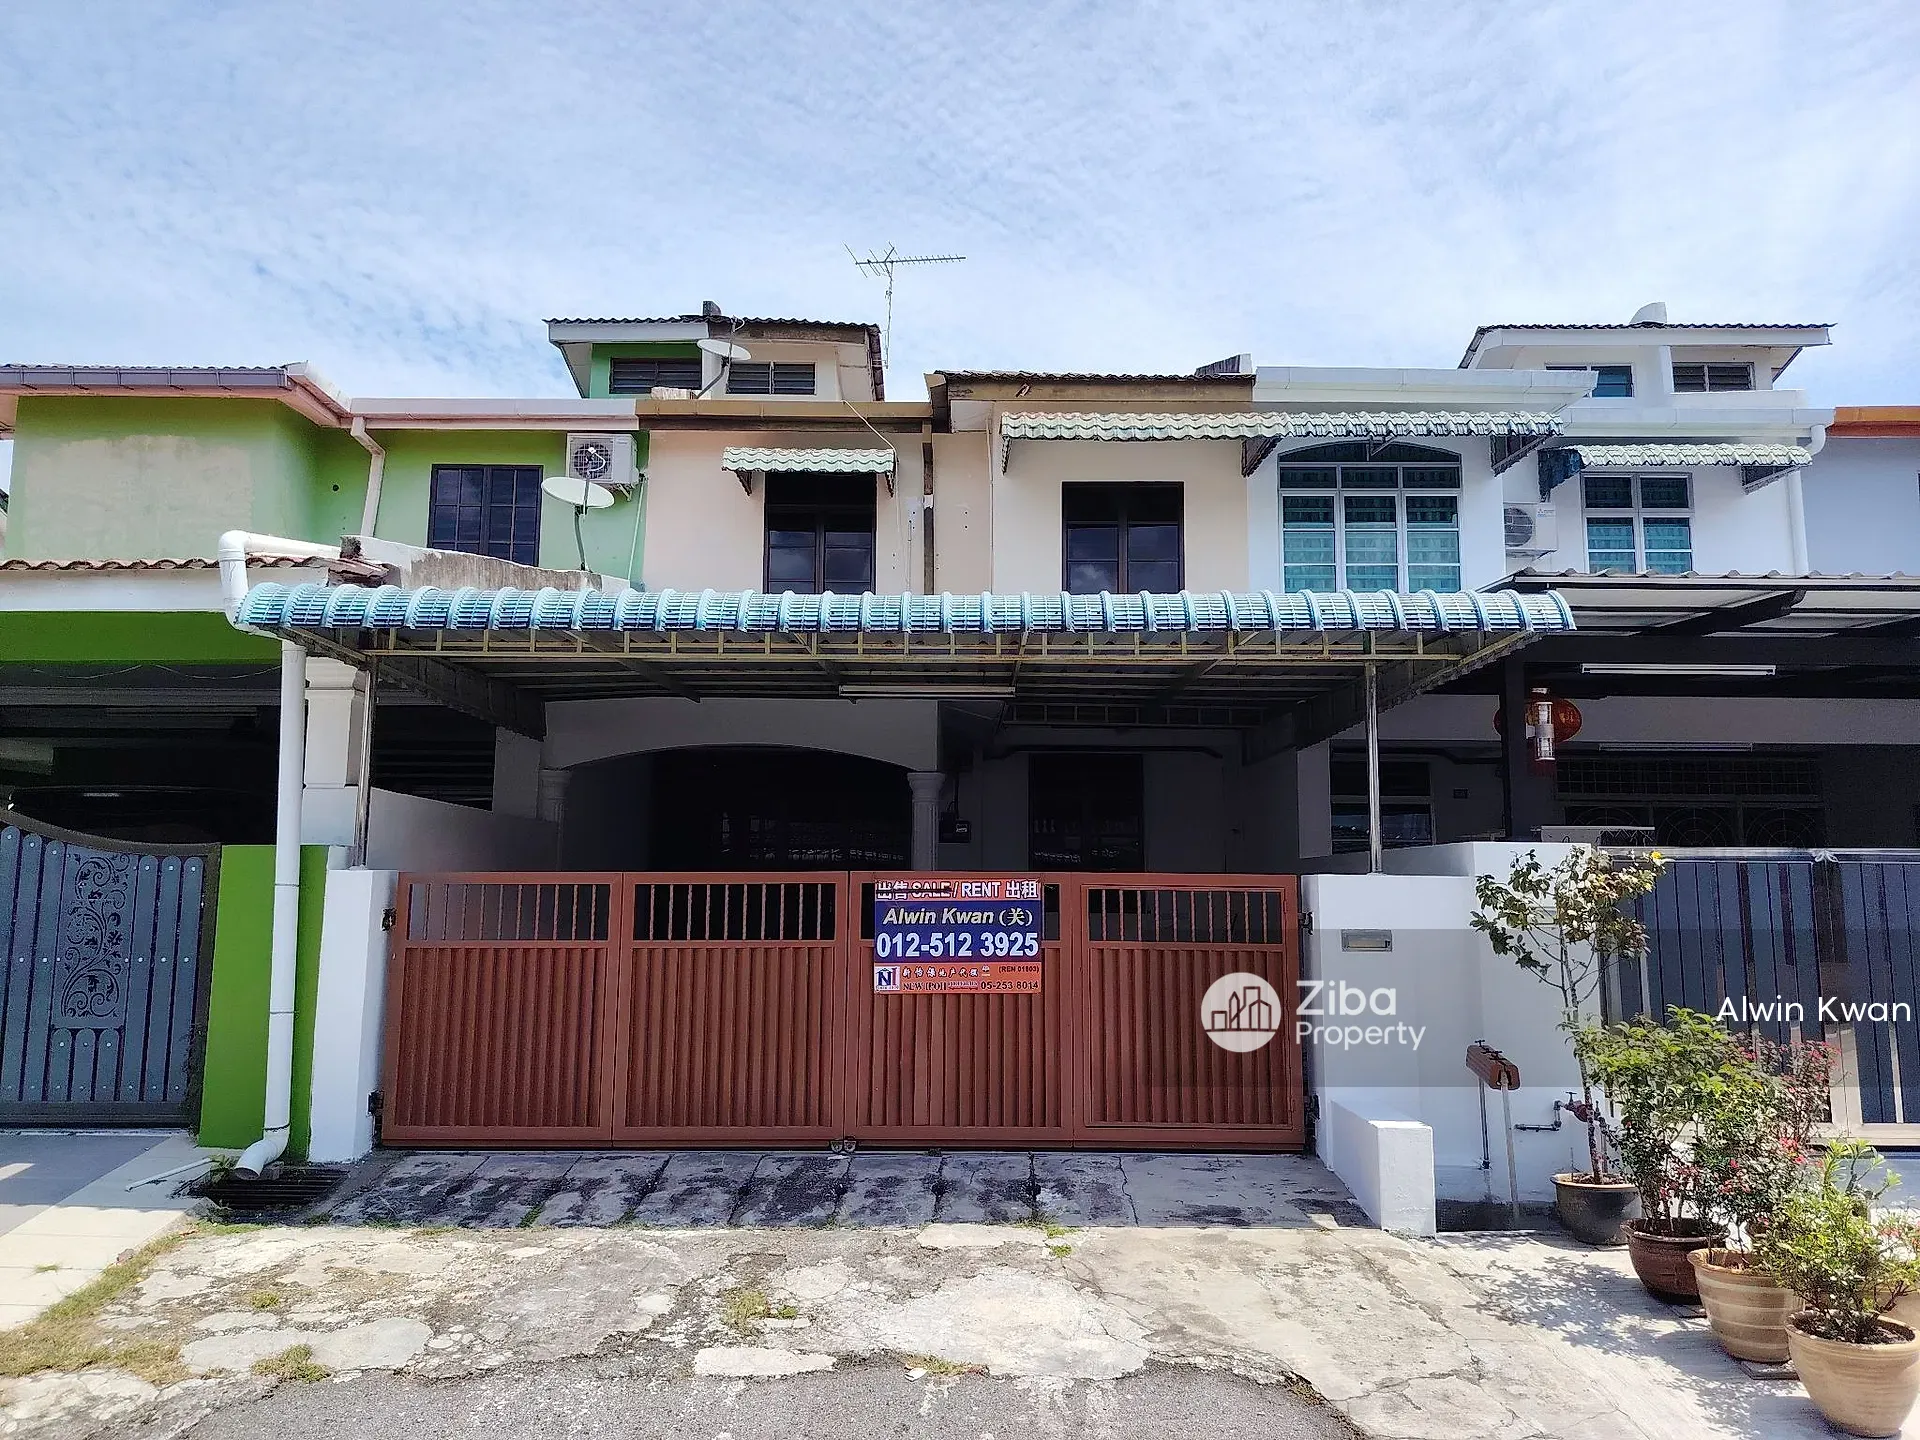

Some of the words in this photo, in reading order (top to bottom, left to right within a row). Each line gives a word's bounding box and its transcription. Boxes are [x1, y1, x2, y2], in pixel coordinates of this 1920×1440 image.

[877, 880, 908, 900] 出售
[961, 882, 1001, 898] RENT
[1005, 880, 1039, 899] 出租
[882, 907, 937, 925] Alwin
[941, 907, 995, 925] Kwan
[876, 932, 973, 957] 012-512
[979, 932, 1039, 957] 3925
[980, 981, 1014, 990] 05-253
[1016, 981, 1039, 990] 8014
